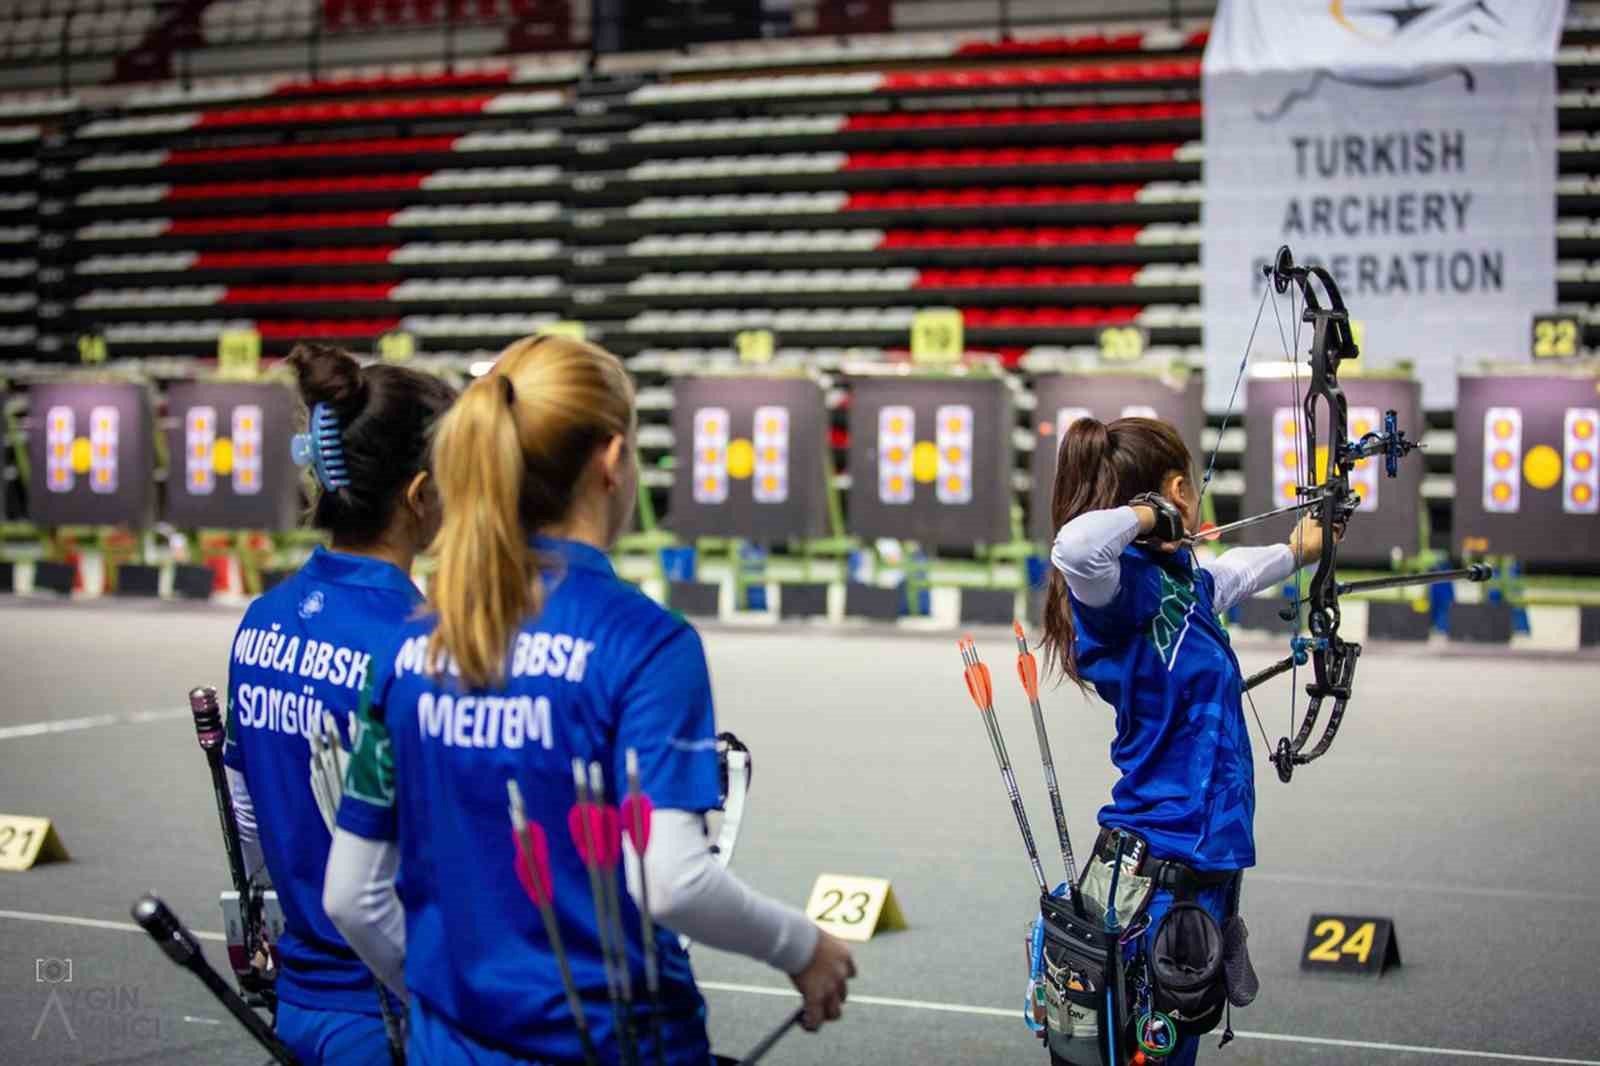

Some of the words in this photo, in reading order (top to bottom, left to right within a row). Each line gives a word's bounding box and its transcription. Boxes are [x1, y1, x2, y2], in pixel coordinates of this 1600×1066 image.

[1290, 132, 1464, 177] TURKISH
[1282, 194, 1472, 237] ARCHERY
[1534, 322, 1576, 356] 22
[234, 622, 296, 675] MUĞLA
[301, 639, 371, 691] BBSK
[815, 888, 871, 924] 23
[1308, 918, 1377, 964] 24
